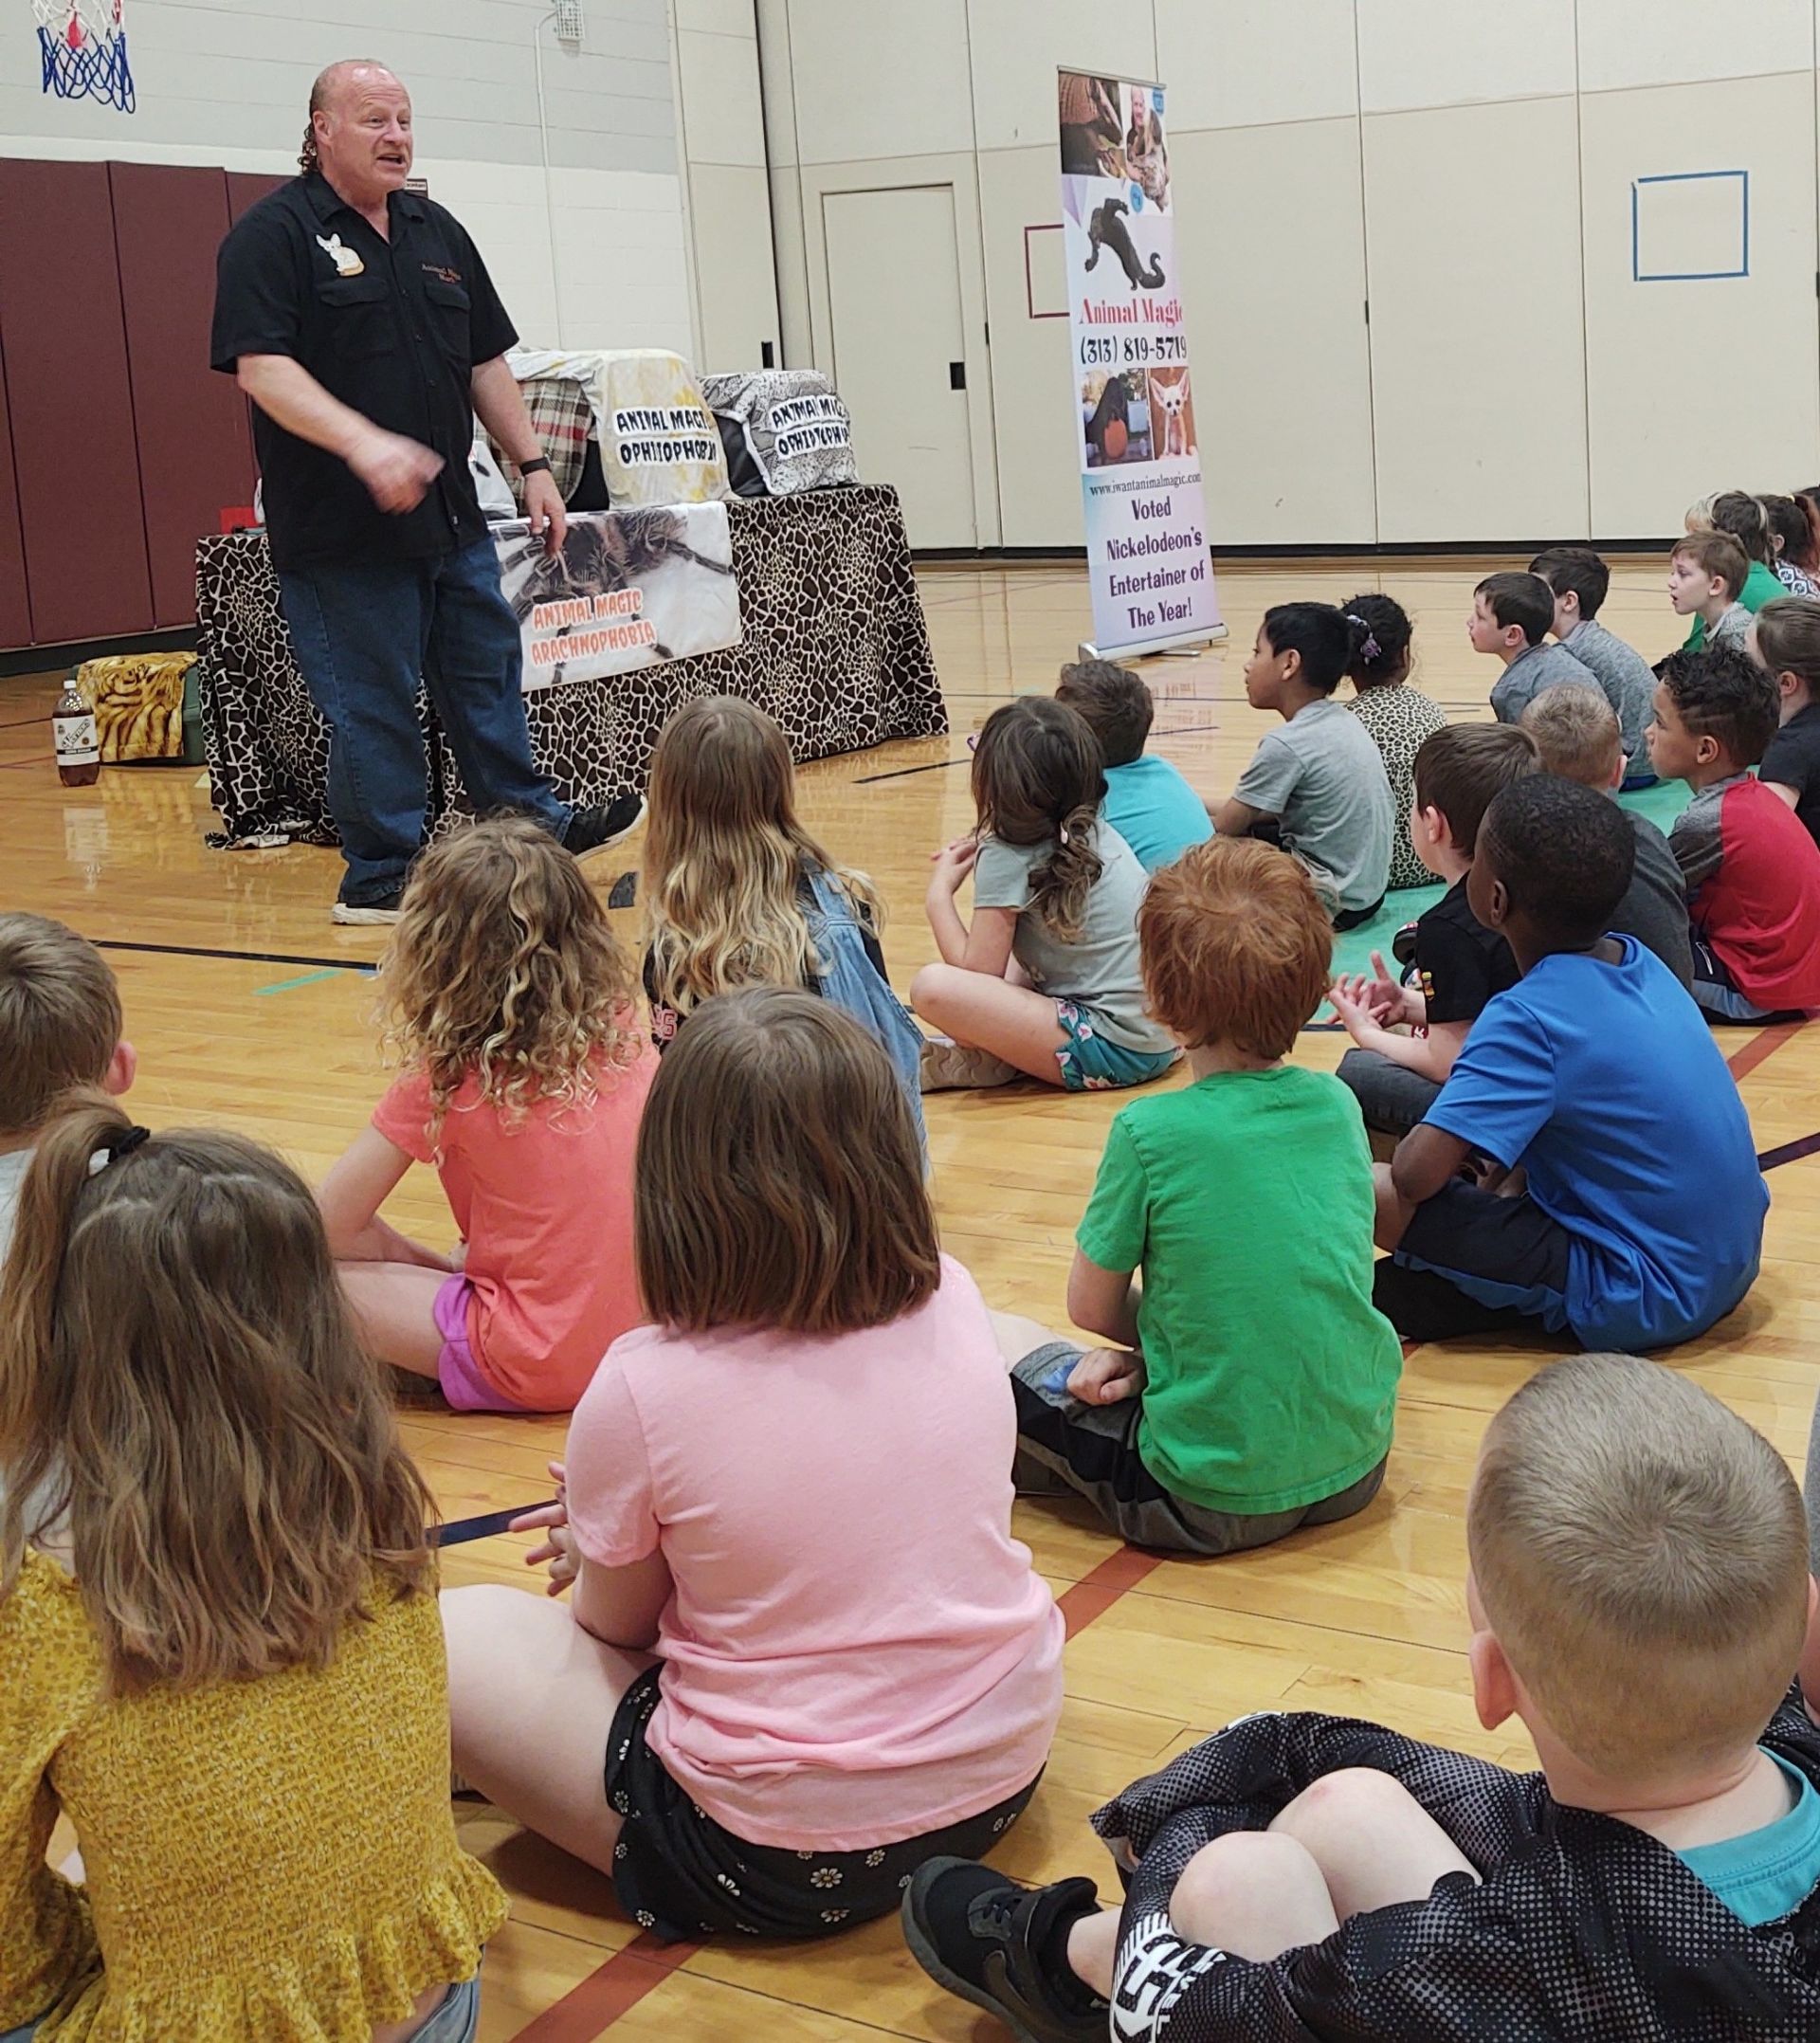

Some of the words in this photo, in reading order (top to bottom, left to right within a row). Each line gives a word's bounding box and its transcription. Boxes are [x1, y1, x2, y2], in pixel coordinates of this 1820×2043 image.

[1079, 298, 1138, 324] Animal
[1141, 298, 1183, 329] Magic
[1081, 335, 1118, 365] (313)
[1123, 335, 1187, 362] 819-5719
[669, 410, 709, 430] MAGI
[1131, 496, 1172, 520] Voted
[1106, 526, 1203, 561] Nickelodeon's
[1109, 567, 1186, 597] Entertainer
[1190, 559, 1205, 581] of
[534, 599, 592, 630] ANIMAL
[595, 591, 642, 618] MAGIC
[1127, 606, 1156, 629] The
[1157, 596, 1192, 623] Year!
[532, 621, 656, 666] ARACHNOPHOBIA
